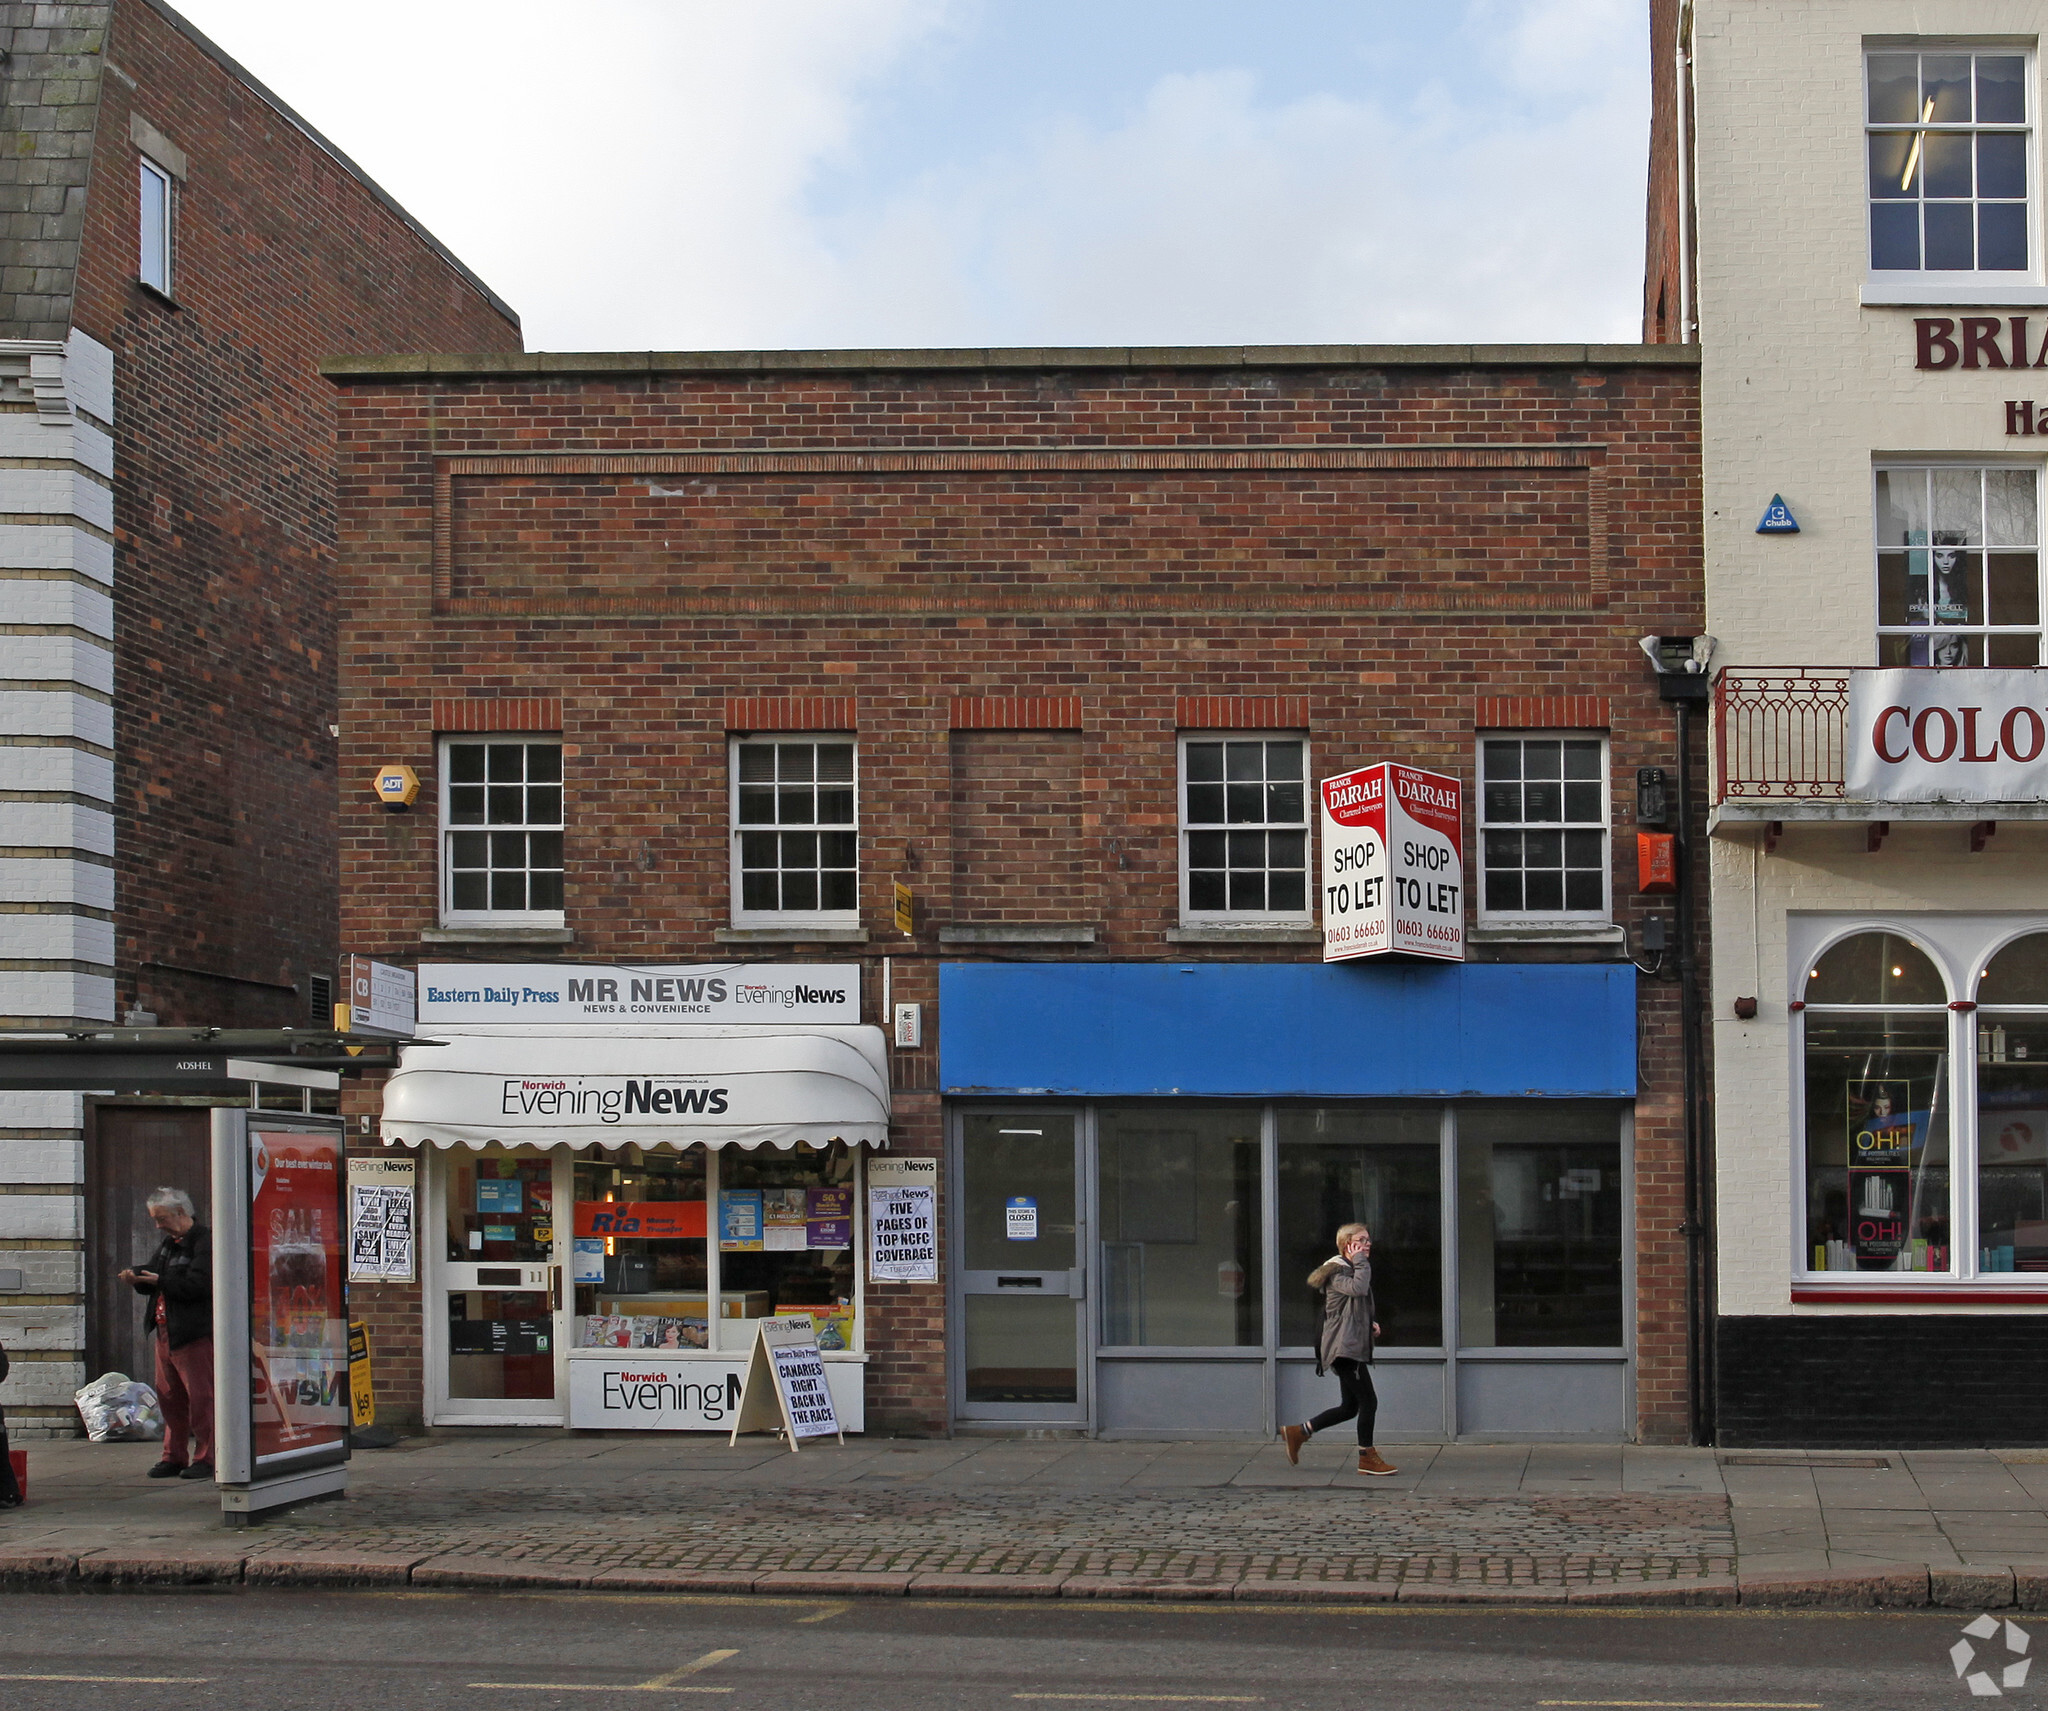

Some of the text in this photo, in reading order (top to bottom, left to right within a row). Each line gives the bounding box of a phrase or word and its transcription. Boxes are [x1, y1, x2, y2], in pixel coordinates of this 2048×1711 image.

[1765, 519, 1792, 527] Chubb
[1872, 705, 2048, 764] COLO
[1329, 777, 1351, 790] FRANCIS
[1398, 769, 1423, 782] FRANCIS
[383, 780, 403, 788] ADT
[1329, 778, 1382, 810] DARRAH
[1398, 779, 1457, 810] DARRAH
[1339, 802, 1383, 819] Chartered Surveyors
[1334, 842, 1375, 873] SHOP
[1403, 841, 1450, 872] SHOP
[1327, 876, 1384, 915] TO LET
[1395, 876, 1459, 915] TO LET
[1327, 919, 1385, 943] 01603 666630
[1396, 919, 1461, 943] 01603 666630
[356, 977, 369, 997] CB
[567, 978, 728, 1003] MR NEWS
[427, 987, 560, 1006] Eastern Daily Press
[583, 1004, 711, 1013] NEWS & CONVENIENCE
[176, 1061, 213, 1070] ADSHEL
[522, 1081, 566, 1090] Norwich
[1856, 1131, 1900, 1150] OH!
[889, 1202, 912, 1215] FIVE
[270, 1208, 322, 1246] SALE
[591, 1206, 639, 1232] Ria
[876, 1216, 928, 1231] PAGES OF
[646, 1226, 682, 1234] Transfer
[1858, 1222, 1902, 1241] OH!
[876, 1232, 929, 1247] TOP NCFC
[875, 1247, 933, 1262] COVERAGE
[530, 1271, 542, 1282] 11
[889, 1265, 920, 1273] TUESDAY
[621, 1372, 667, 1382] Norwich
[779, 1362, 822, 1378] CANARIES
[791, 1379, 818, 1393] RIGHT
[791, 1393, 827, 1409] BACK IN
[791, 1408, 834, 1424] THE RACE
